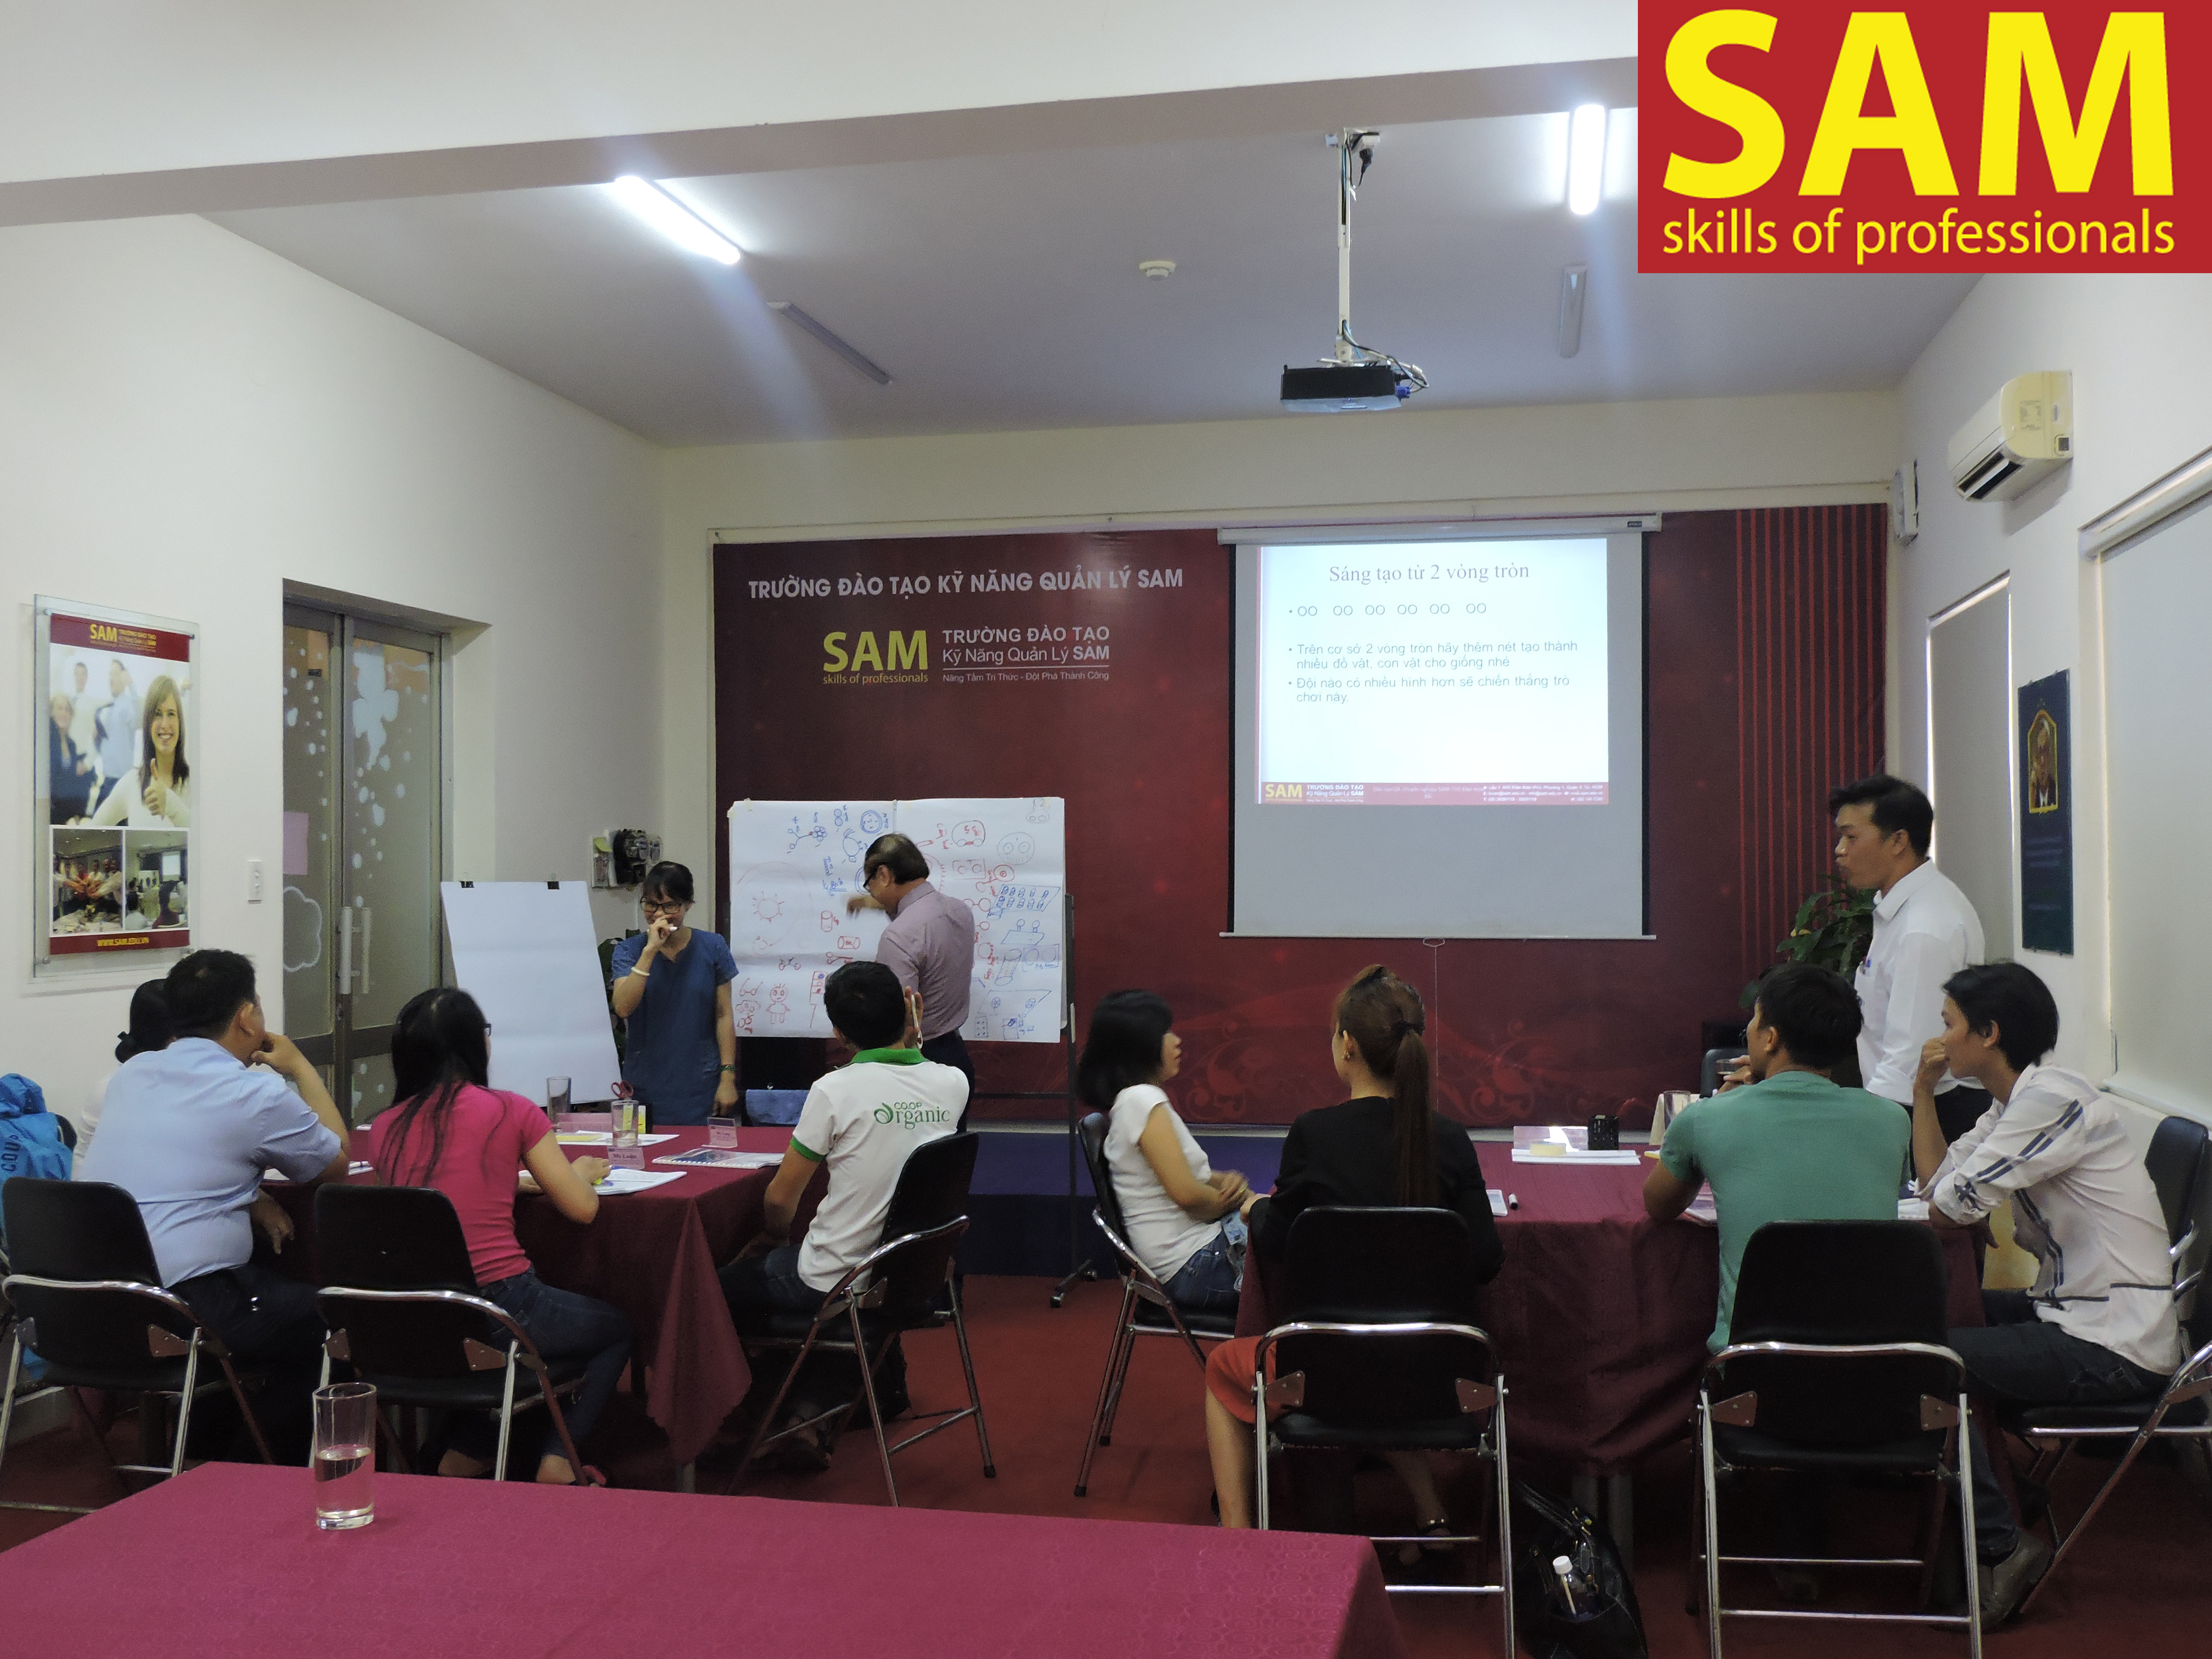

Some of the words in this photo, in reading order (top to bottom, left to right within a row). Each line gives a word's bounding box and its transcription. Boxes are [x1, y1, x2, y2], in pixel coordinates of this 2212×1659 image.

[748, 574, 831, 598] TRƯỜNG
[838, 572, 883, 596] ĐÀO
[890, 576, 931, 600] TẠO
[938, 571, 964, 593] KỸ
[971, 569, 1033, 592] NĂNG
[1039, 565, 1101, 591] QUẢN
[1109, 565, 1131, 589] LÝ
[1138, 568, 1183, 588] SAM
[1330, 565, 1371, 585] Sáng
[1377, 567, 1402, 584] tạo
[1407, 565, 1425, 580] từ
[1430, 565, 1440, 580] 2
[1446, 564, 1489, 583] vòng
[1494, 563, 1529, 578] tròn
[90, 624, 118, 642] SAM
[942, 626, 1022, 644] TRƯỜNG
[1027, 625, 1067, 642] ĐÀO
[1072, 626, 1110, 644] TẠO
[823, 630, 928, 673] SAM
[943, 649, 962, 666] Kỹ
[965, 648, 1003, 665] Năng
[1008, 646, 1047, 662] Quản
[1052, 646, 1069, 664] Lý
[1073, 646, 1110, 661] SAM
[1297, 644, 1323, 654] Trên
[1327, 646, 1343, 654] cơ
[1366, 644, 1373, 654] 2
[1377, 643, 1405, 656] vòng
[1410, 643, 1433, 653] tròn
[1438, 642, 1459, 655] hãy
[1464, 642, 1493, 652] thêm
[1498, 641, 1516, 652] nét
[1521, 642, 1540, 653] tạo
[1544, 640, 1578, 651] thành
[1297, 656, 1328, 669] nhiều
[1352, 658, 1372, 670] vật,
[1377, 659, 1399, 668] con
[1403, 657, 1420, 670] vật
[1425, 657, 1446, 668] cho
[1451, 654, 1483, 670] giống
[1488, 656, 1510, 667] nhé
[823, 673, 847, 684] skills
[849, 673, 860, 683] of
[862, 672, 928, 685] professionals
[1297, 677, 1317, 690] Đội
[1321, 677, 1342, 688] nào
[1346, 677, 1360, 688] có
[1365, 675, 1396, 687] nhiều
[1432, 676, 1455, 687] hơn
[1460, 676, 1473, 686] sẽ
[1478, 673, 1510, 686] chiến
[1515, 673, 1548, 688] thắng
[1554, 675, 1570, 686] trò
[1297, 692, 1322, 702] chơi
[1265, 783, 1303, 798] SAM
